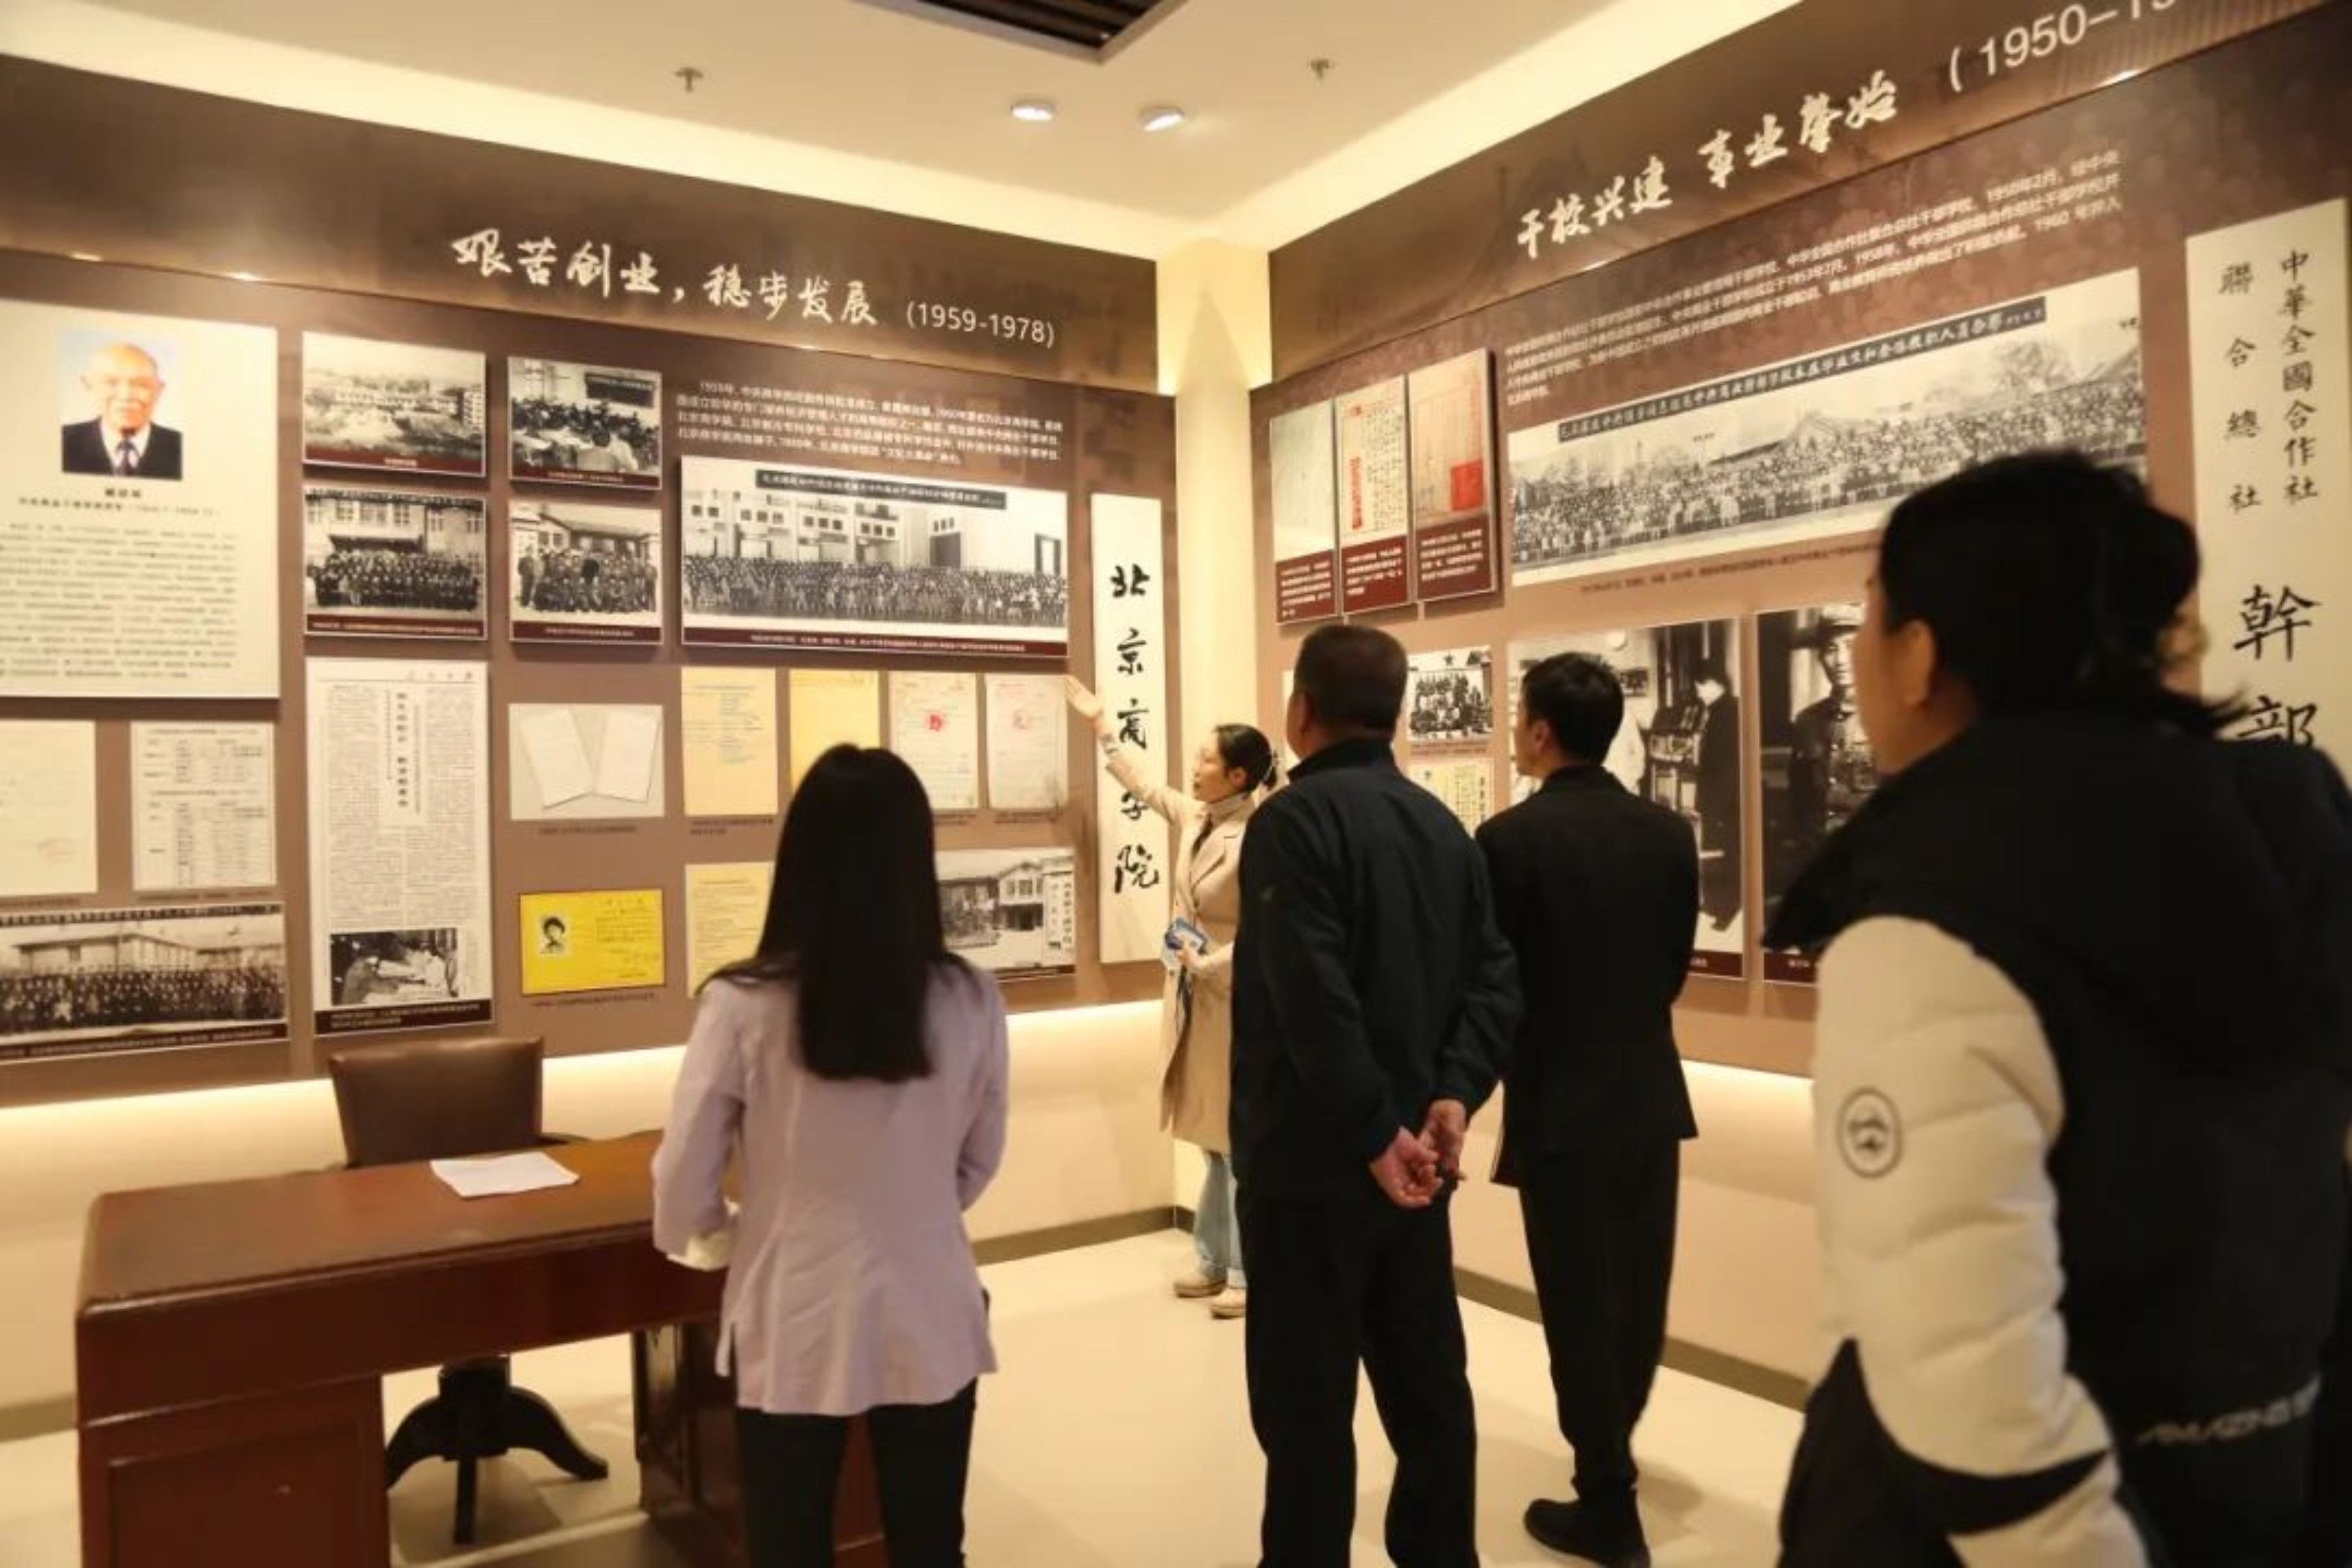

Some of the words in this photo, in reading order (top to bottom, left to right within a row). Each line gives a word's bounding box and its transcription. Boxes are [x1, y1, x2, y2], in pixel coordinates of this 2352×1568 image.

[1516, 154, 1673, 260] 干校兴建
[906, 300, 1055, 349] (1959-1978)
[2277, 249, 2319, 507] 中華全國合作社
